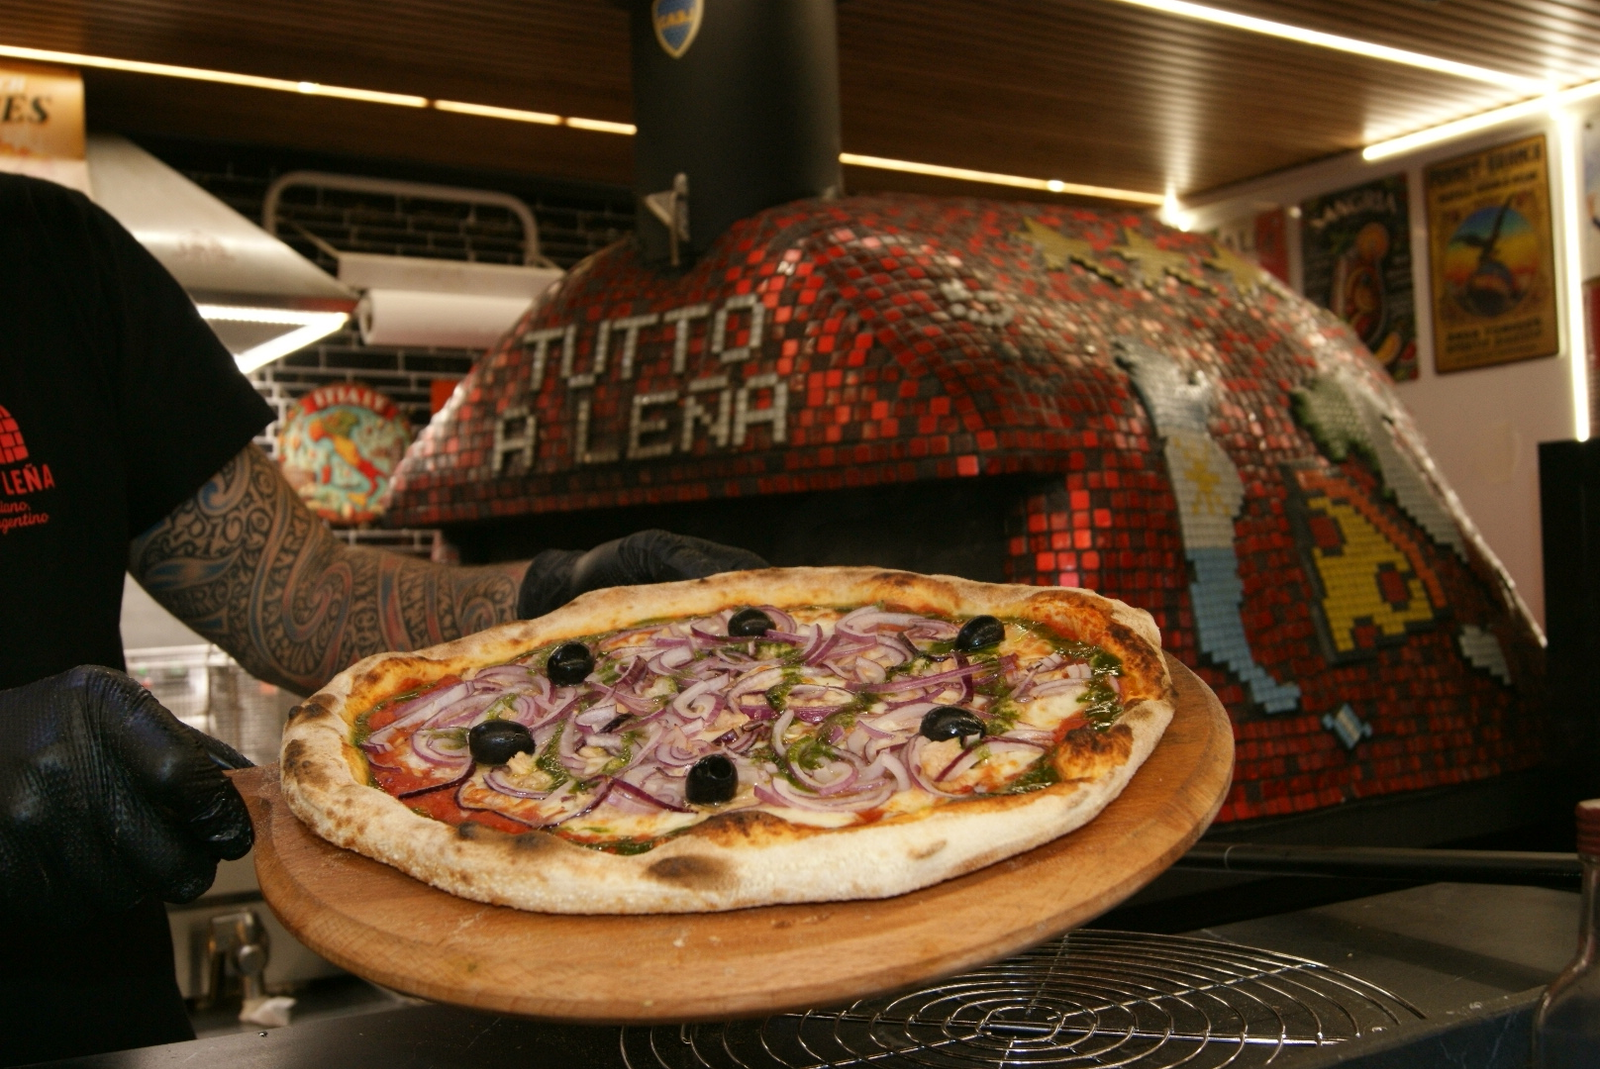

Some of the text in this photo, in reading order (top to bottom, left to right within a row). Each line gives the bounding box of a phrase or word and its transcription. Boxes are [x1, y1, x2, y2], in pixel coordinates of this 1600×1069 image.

[0, 94, 51, 124] ES
[523, 293, 765, 391] TUTTO
[492, 373, 787, 471] A LEÑA
[1, 463, 56, 495] LEÑA
